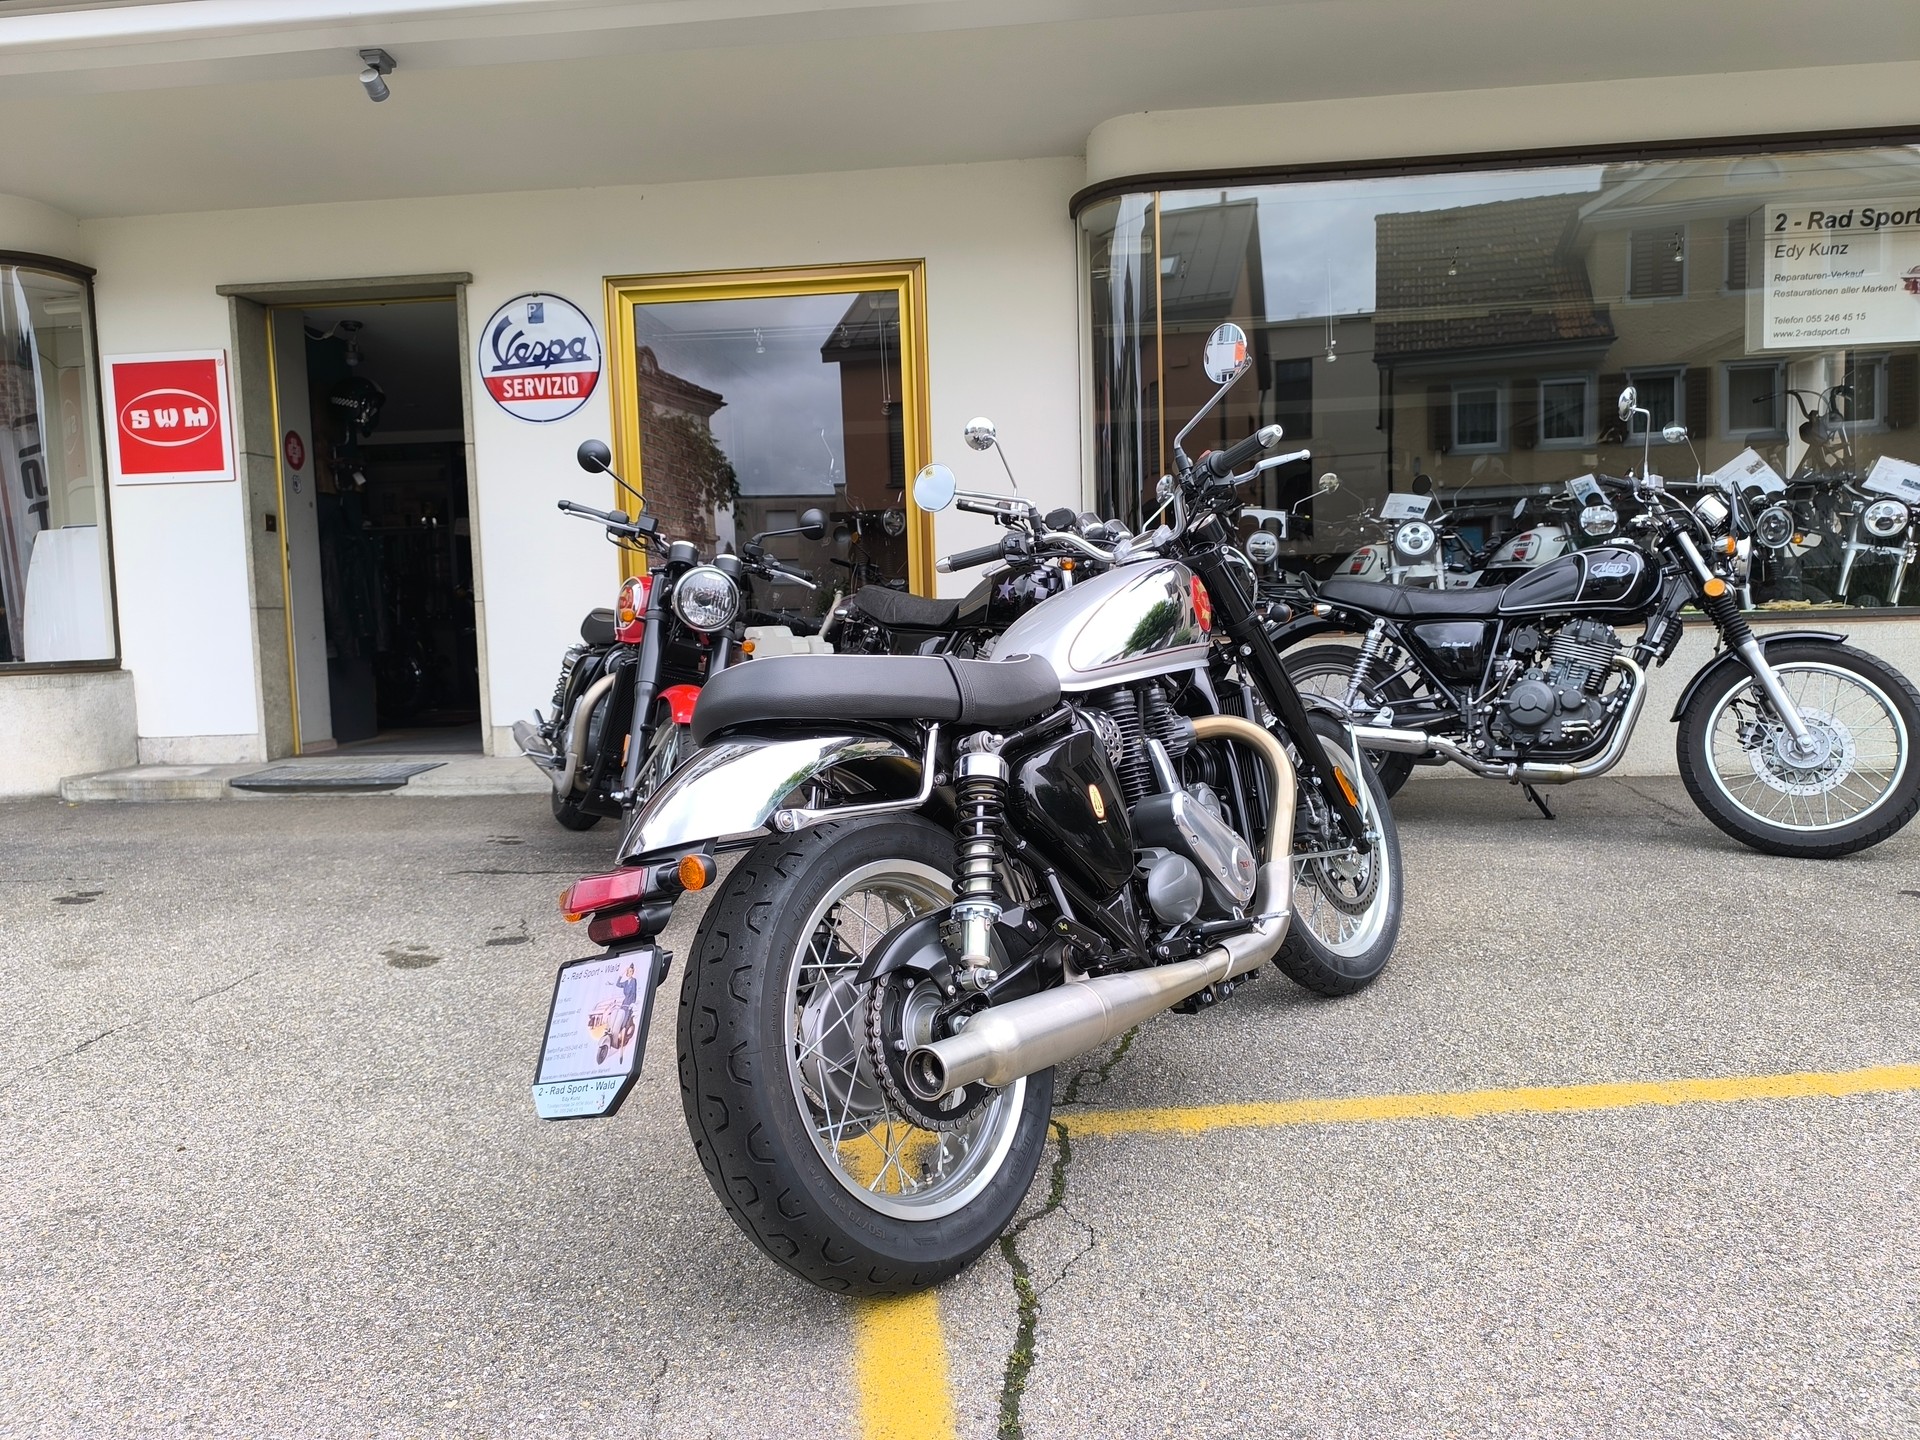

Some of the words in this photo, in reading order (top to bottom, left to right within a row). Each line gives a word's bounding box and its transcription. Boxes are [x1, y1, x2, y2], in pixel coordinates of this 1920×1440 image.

[1774, 213, 1788, 232] 2
[1807, 209, 1854, 230] Rad
[1774, 244, 1805, 260] Edy
[1809, 243, 1849, 257] Kunz
[1773, 269, 1865, 283] Reparaturen-Verkauf
[1773, 287, 1839, 298] Restaurationen
[1841, 286, 1860, 295] aller
[1862, 284, 1897, 294] Marken!
[1774, 315, 1804, 325] Telefon
[1805, 314, 1822, 324] 055
[1824, 313, 1840, 323] 246
[1842, 313, 1853, 321] 45
[1856, 312, 1866, 321] 15
[1773, 327, 1850, 338] www.2-radsport.ch
[491, 315, 592, 372] Vespa
[502, 375, 579, 398] SERVIZIO
[130, 406, 209, 429] SWM
[538, 1087, 544, 1097] 2
[549, 1085, 566, 1096] Rad
[566, 1083, 589, 1095] Sport
[595, 1080, 616, 1091] Wald
